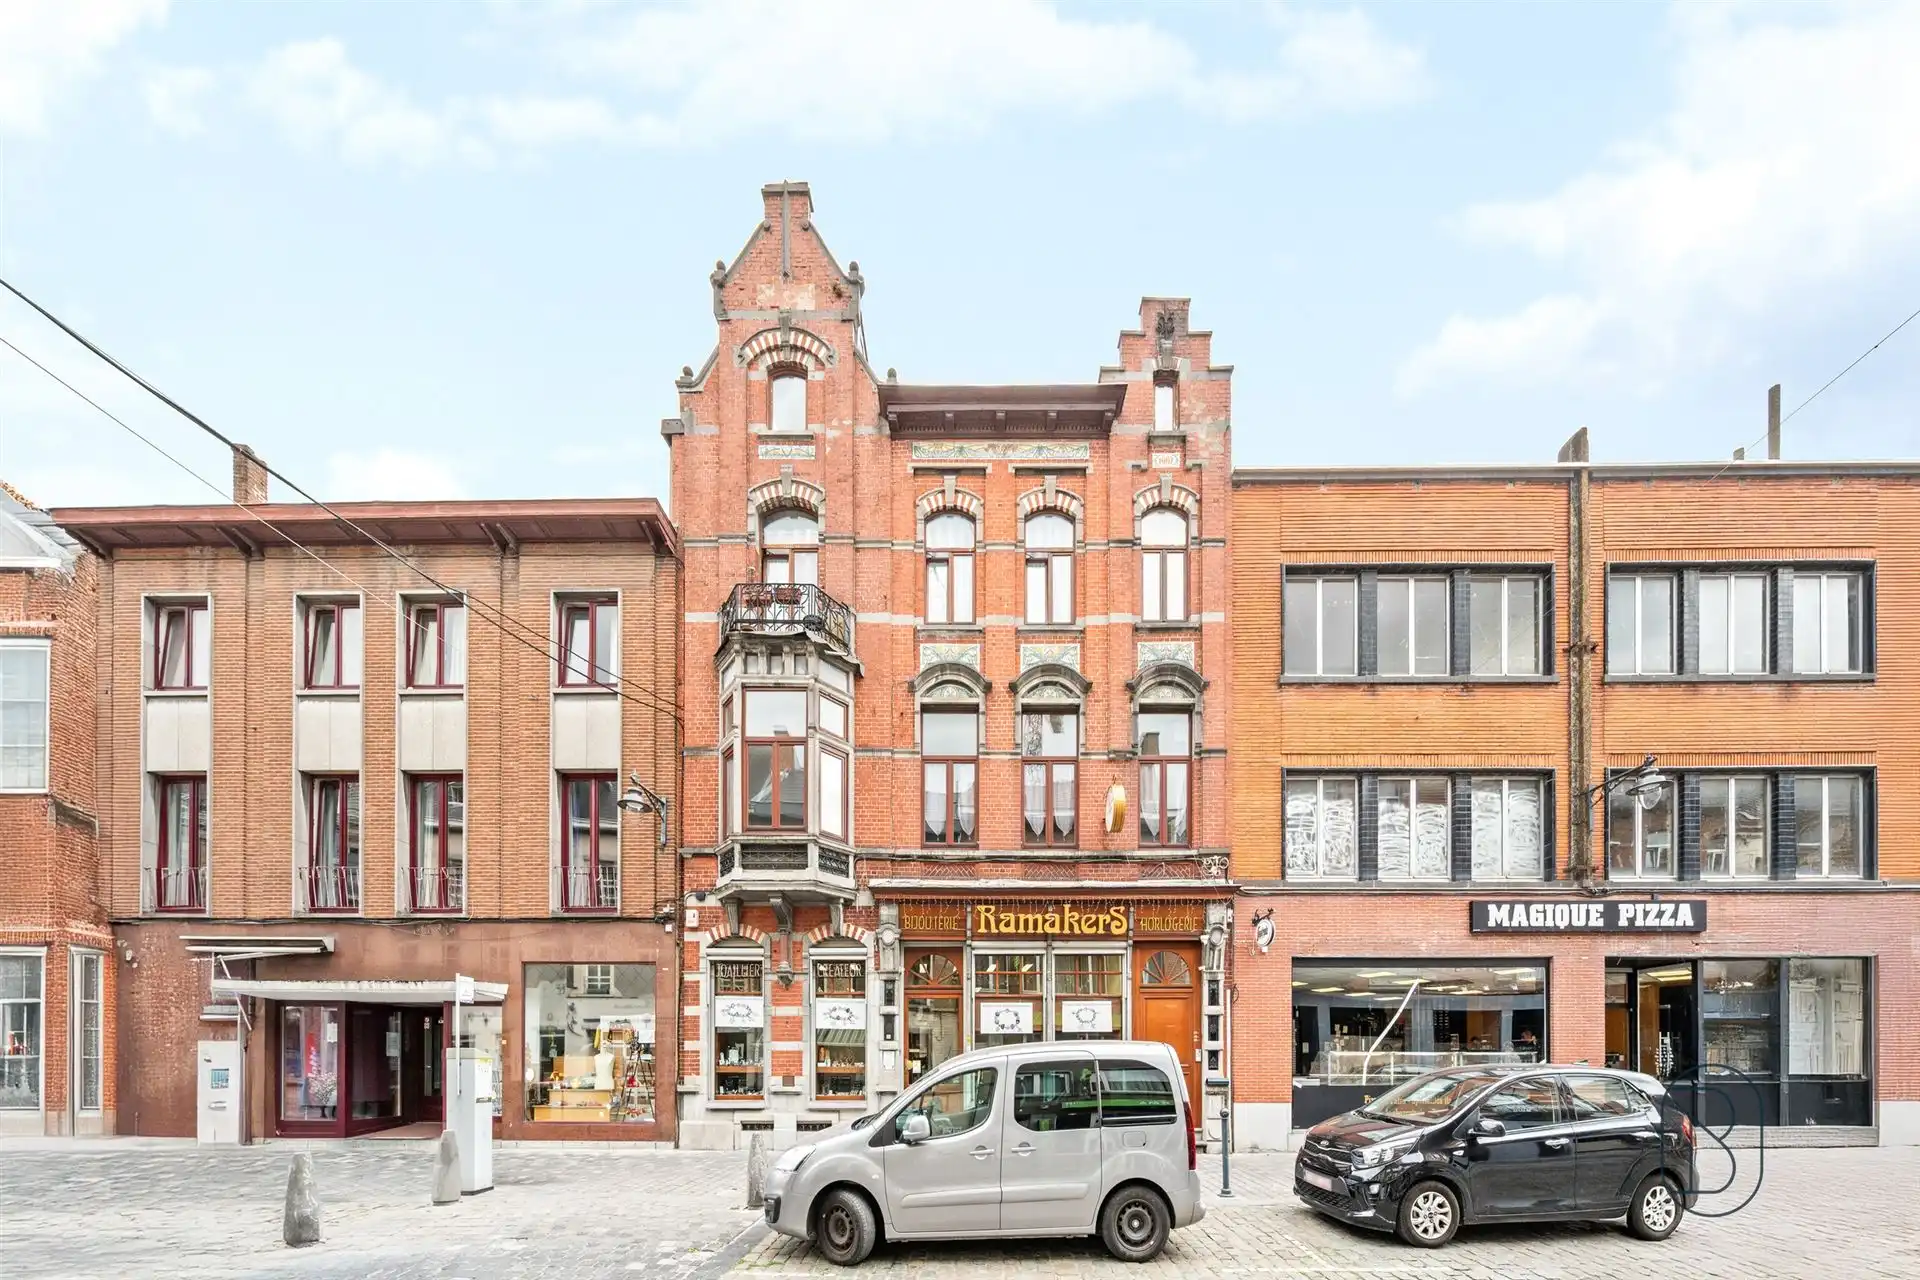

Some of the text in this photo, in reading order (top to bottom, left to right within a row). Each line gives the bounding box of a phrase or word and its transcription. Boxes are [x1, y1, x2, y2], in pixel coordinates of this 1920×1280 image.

[904, 915, 958, 930] BIJOUTERIE
[1140, 916, 1198, 932] HORLOGERIE
[1487, 903, 1694, 929] MAGIQUE PIZZA
